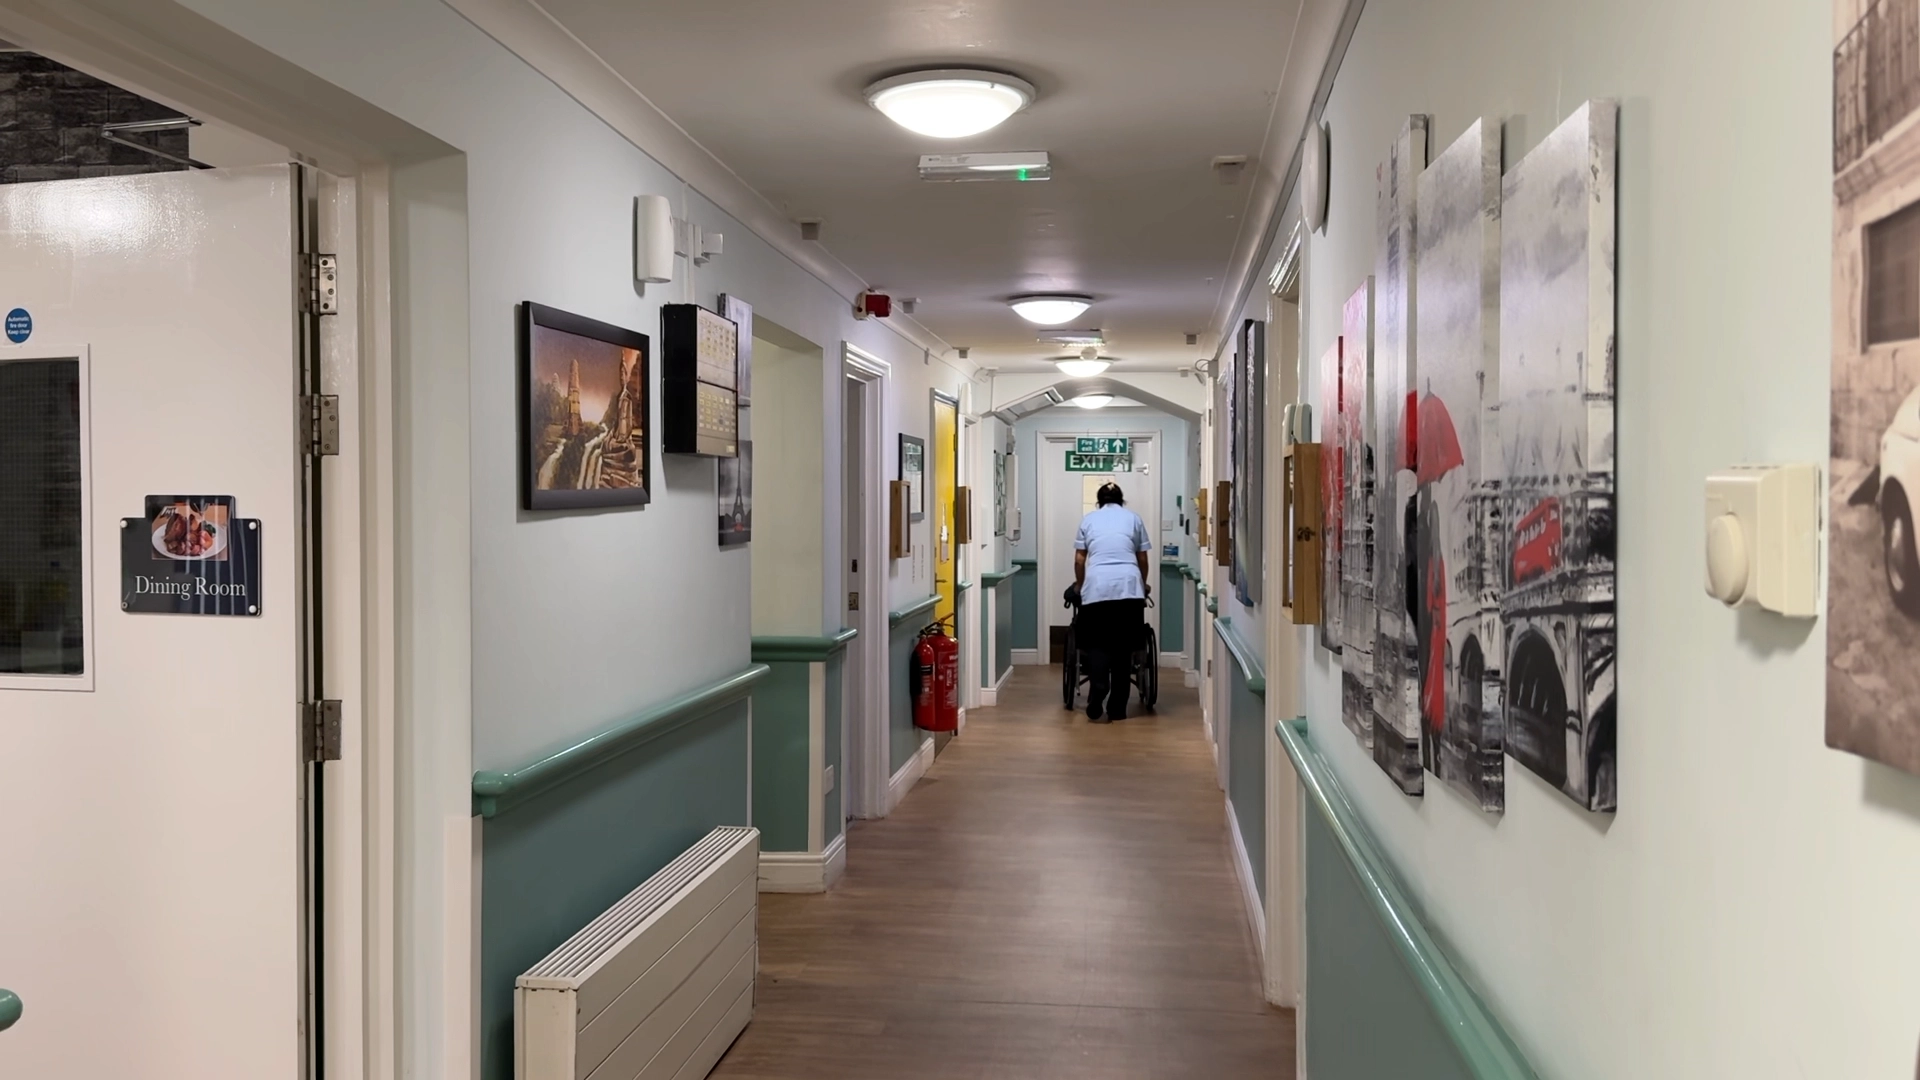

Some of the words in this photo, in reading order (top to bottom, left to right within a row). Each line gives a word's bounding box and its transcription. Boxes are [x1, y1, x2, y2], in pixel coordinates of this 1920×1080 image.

[1070, 455, 1107, 469] EXIT
[135, 575, 191, 601] Dining
[195, 576, 247, 596] Room
